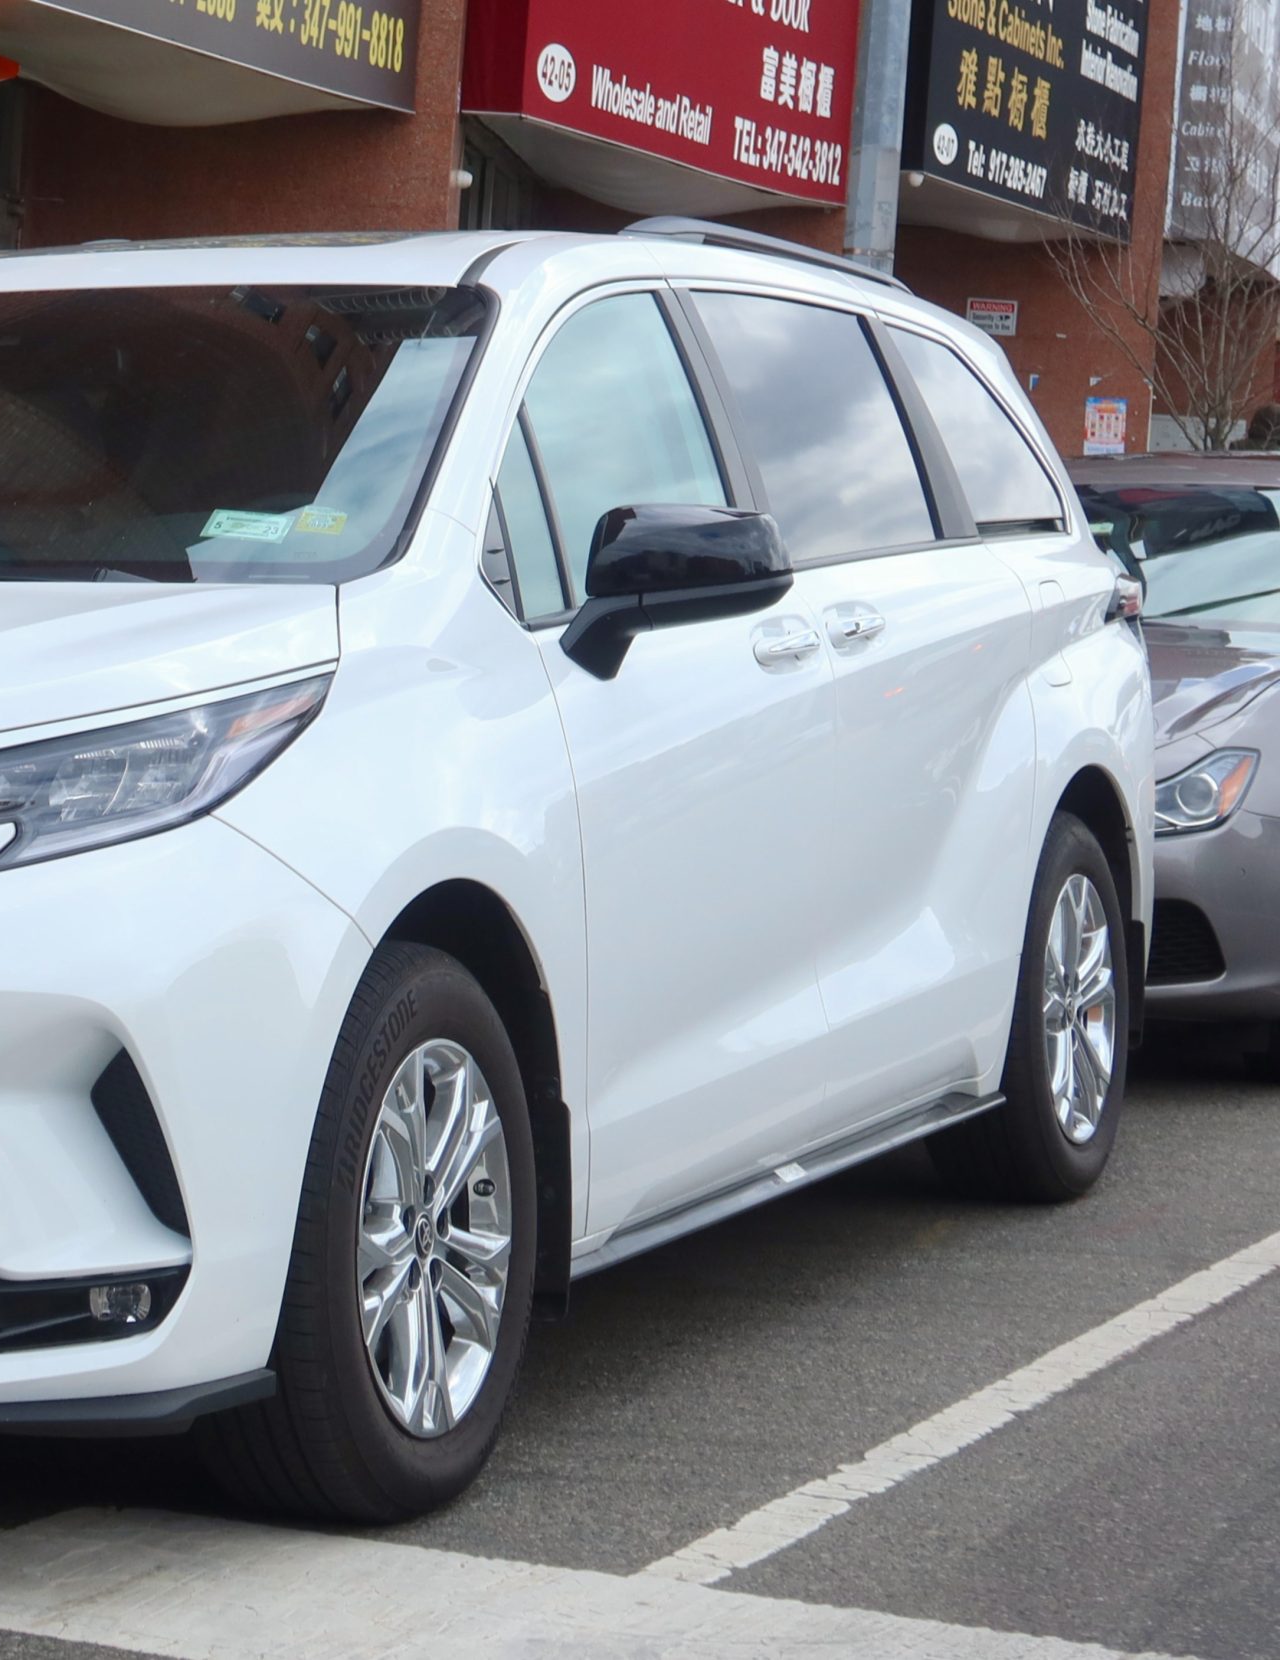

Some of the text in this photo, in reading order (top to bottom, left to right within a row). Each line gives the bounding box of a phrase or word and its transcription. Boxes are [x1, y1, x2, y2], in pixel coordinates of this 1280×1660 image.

[999, 0, 1046, 60] Cabinets
[1046, 23, 1064, 69] Inc.
[591, 64, 713, 145] Wholesale and Retail
[733, 115, 842, 186] TEL: 347-542-3812
[967, 140, 986, 178] Tel:
[972, 302, 1013, 313] WARNING
[334, 989, 419, 1192] BRIDGESTONE
